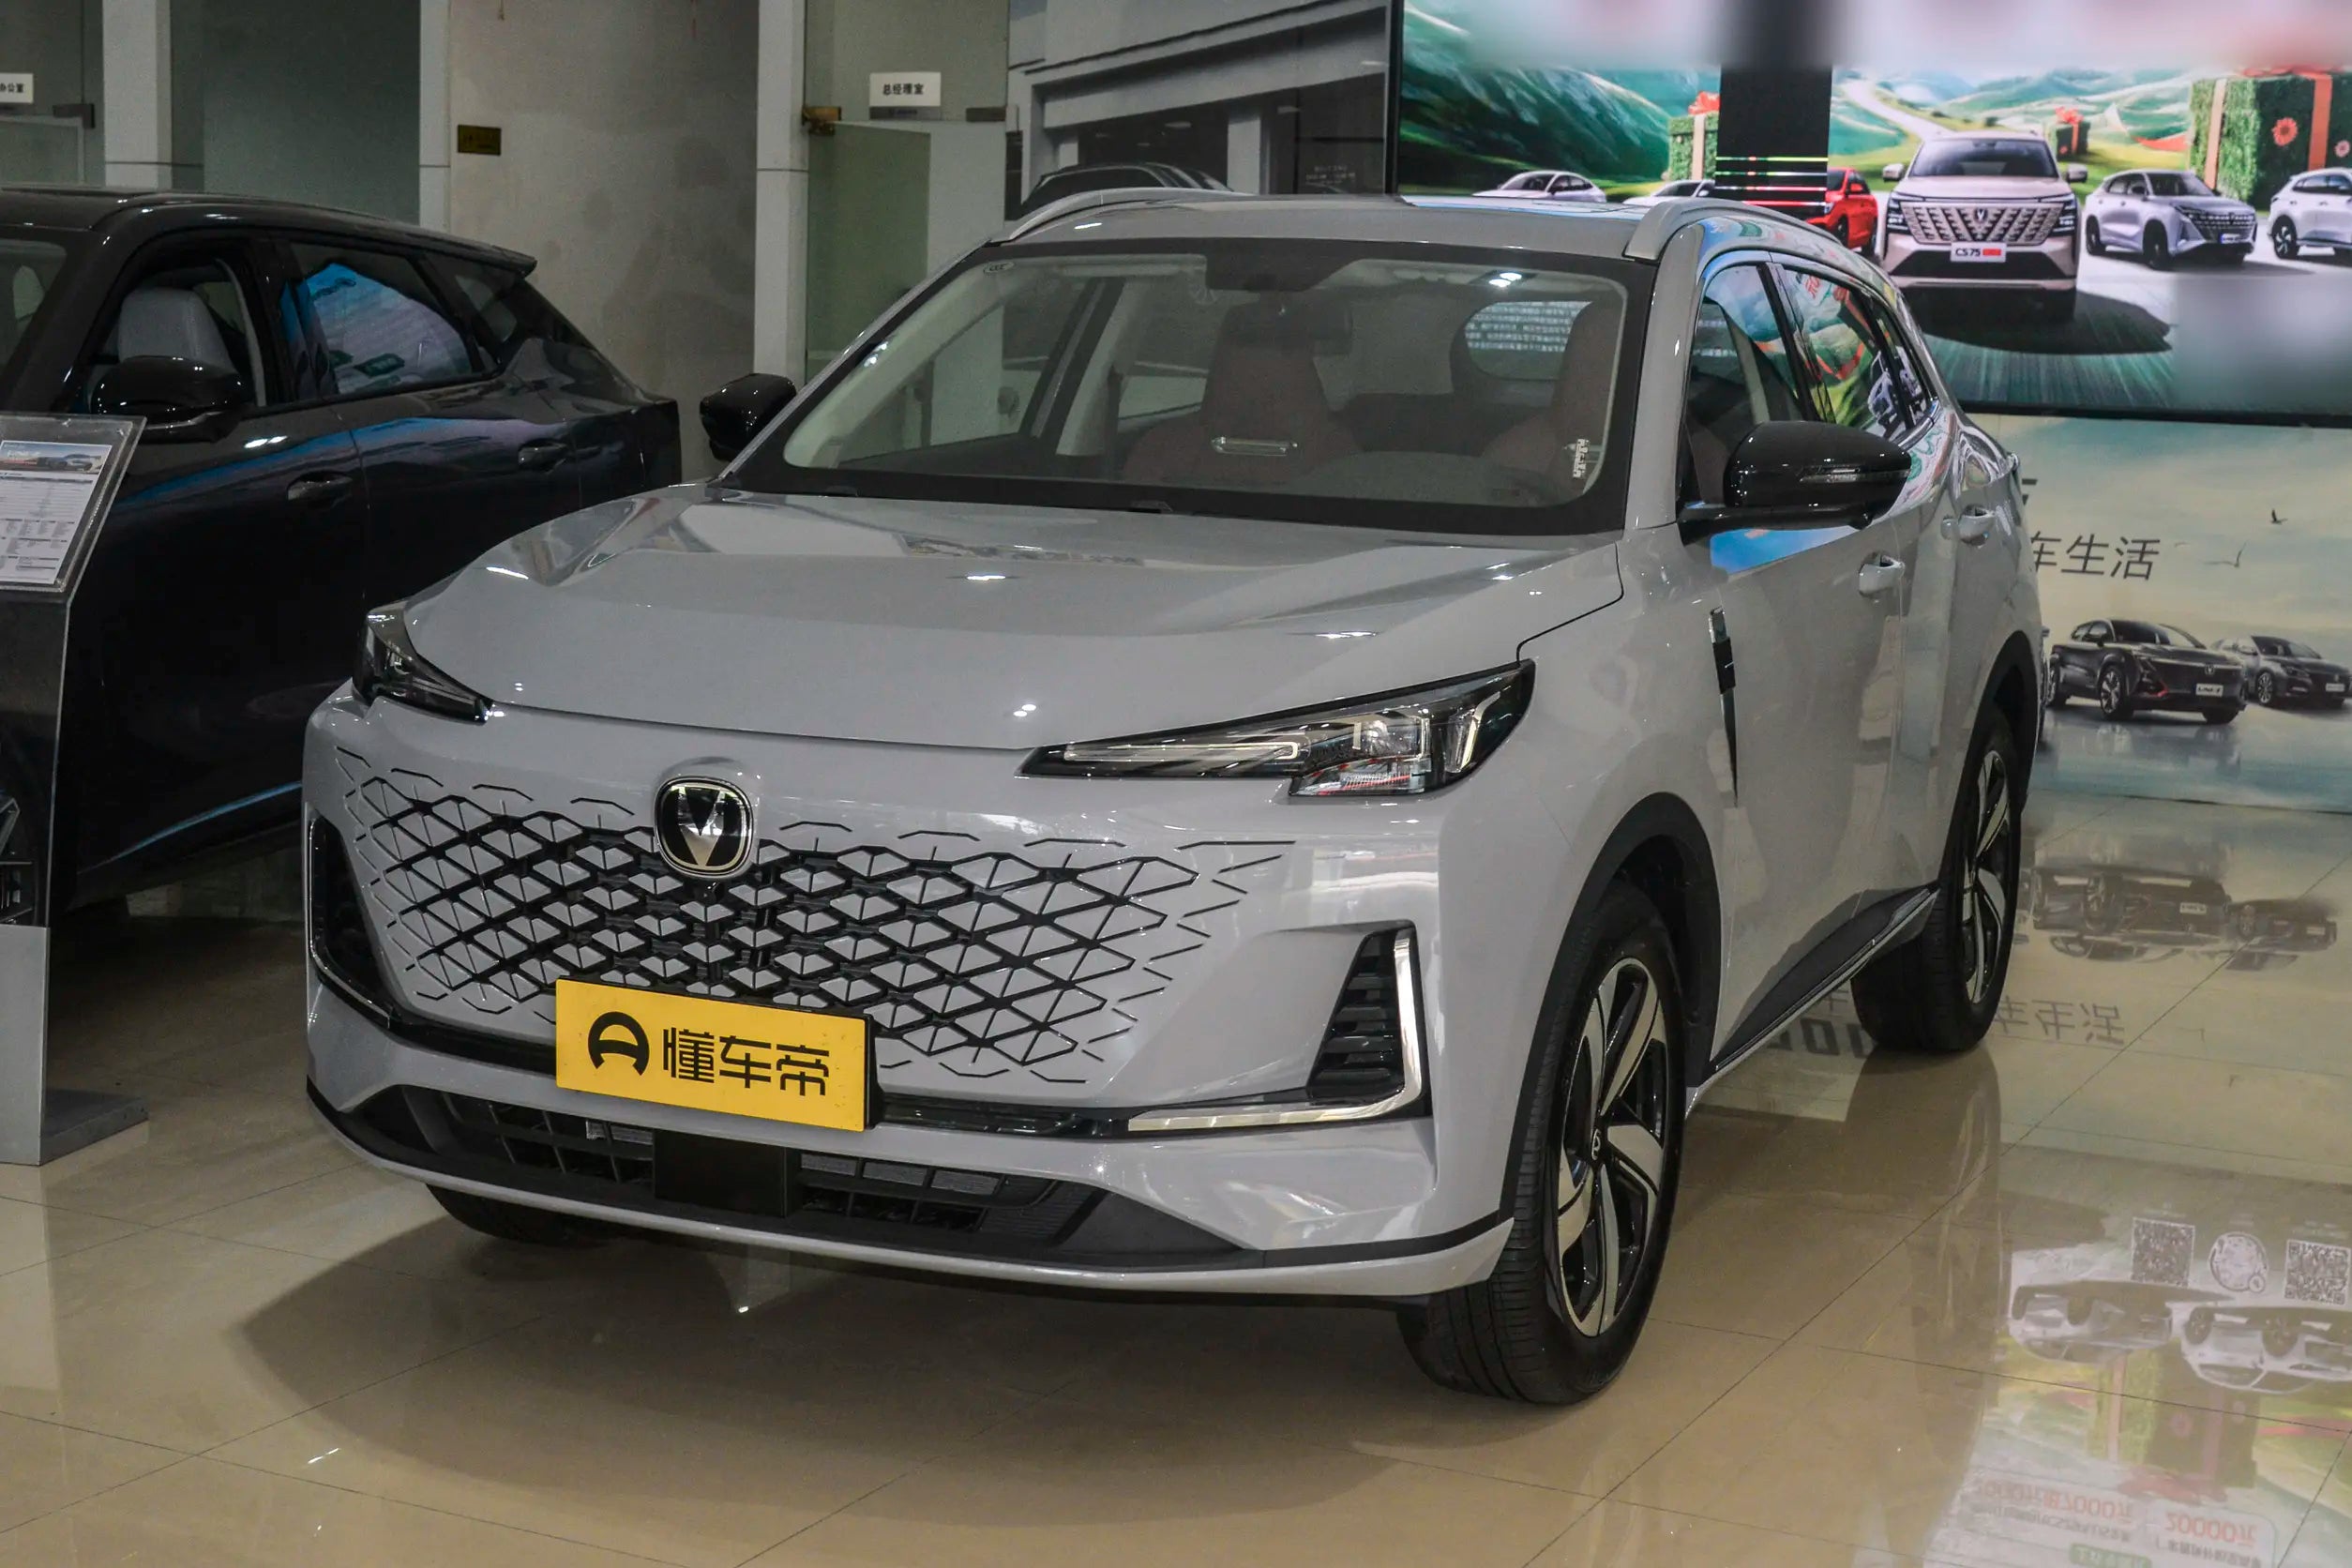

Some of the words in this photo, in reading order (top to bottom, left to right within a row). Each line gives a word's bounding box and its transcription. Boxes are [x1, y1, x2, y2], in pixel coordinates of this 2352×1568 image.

[883, 83, 924, 96] 总经理室
[662, 1027, 830, 1096] 懂车帝
